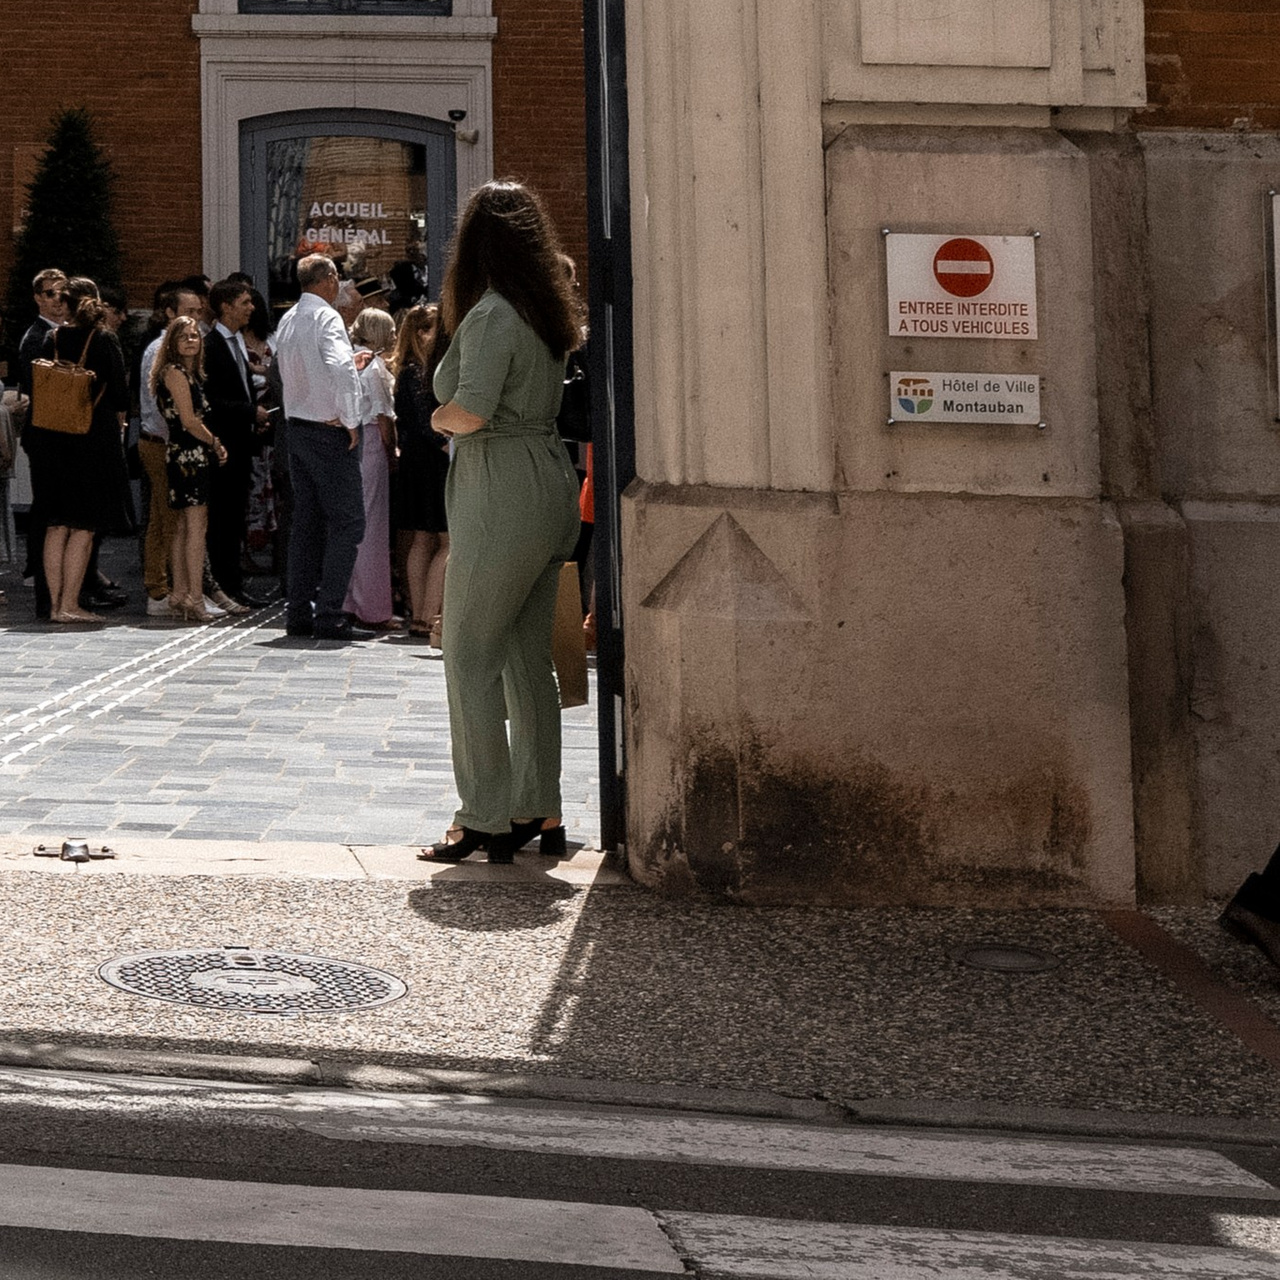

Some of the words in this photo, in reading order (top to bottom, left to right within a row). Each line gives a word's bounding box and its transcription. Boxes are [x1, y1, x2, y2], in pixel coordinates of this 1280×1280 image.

[309, 201, 388, 219] ACCUEIL
[305, 223, 392, 245] GÉNÉRAL
[899, 301, 954, 315] ENTREE
[957, 302, 1029, 317] INTERDITE
[898, 319, 909, 332] A
[911, 319, 949, 333] TOUS
[952, 320, 1030, 335] VEHICULES
[942, 379, 979, 392] Hôtel
[983, 380, 1001, 393] de
[1005, 380, 1036, 393] Ville
[943, 400, 1024, 414] Montauban
